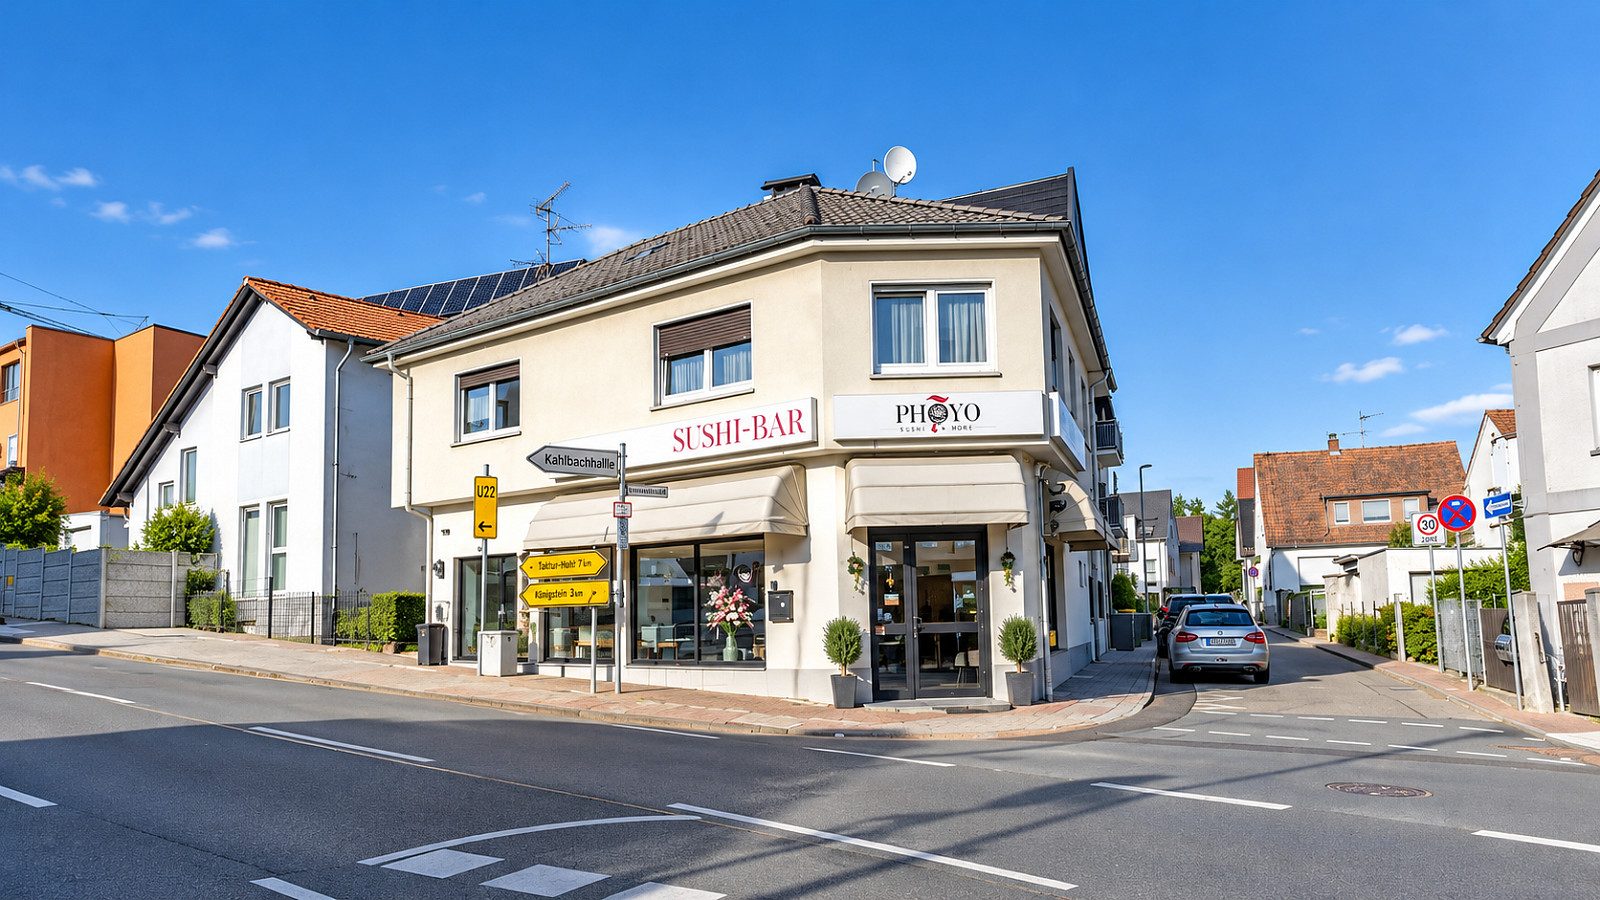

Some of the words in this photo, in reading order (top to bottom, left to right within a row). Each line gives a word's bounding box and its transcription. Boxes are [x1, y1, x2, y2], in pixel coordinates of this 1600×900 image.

[673, 408, 806, 452] SUSHI-BAR
[477, 485, 496, 499] U22
[1422, 519, 1435, 530] 30
[569, 588, 575, 598] 3
